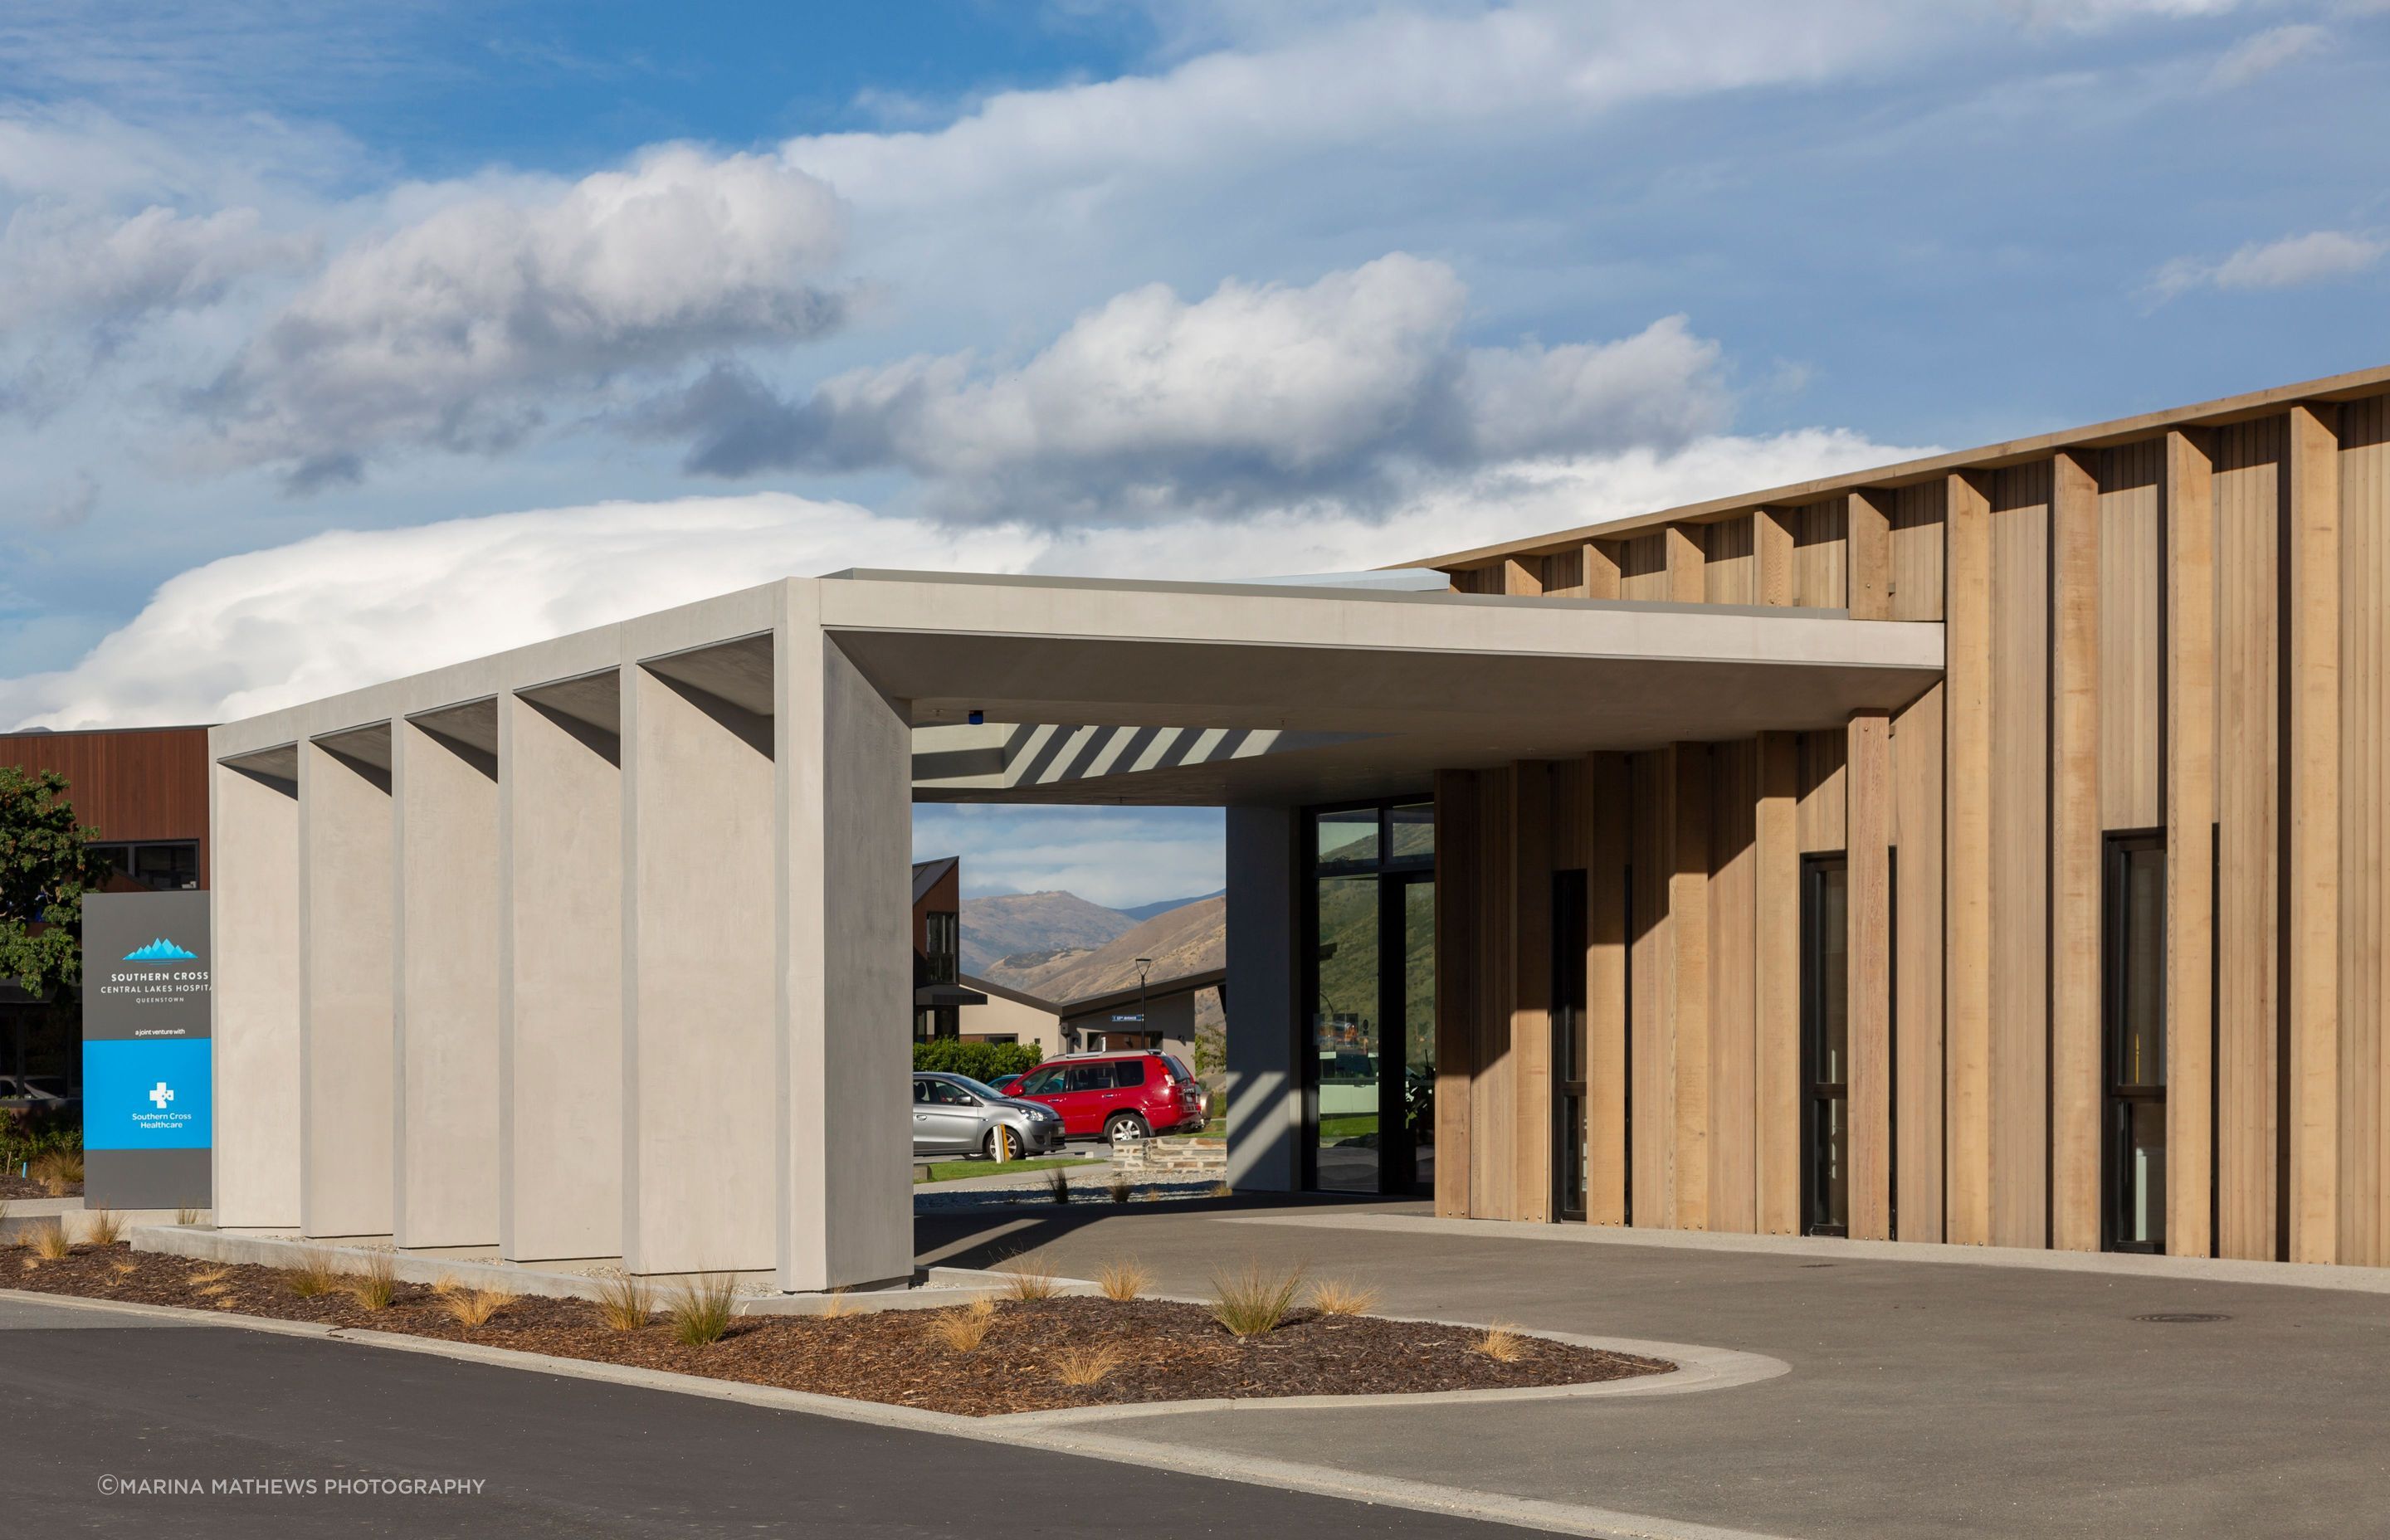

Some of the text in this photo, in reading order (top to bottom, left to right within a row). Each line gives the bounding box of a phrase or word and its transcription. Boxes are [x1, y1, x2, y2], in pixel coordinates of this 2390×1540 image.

[111, 971, 208, 982] SOUTHERN CROSS
[139, 1029, 152, 1037] joint
